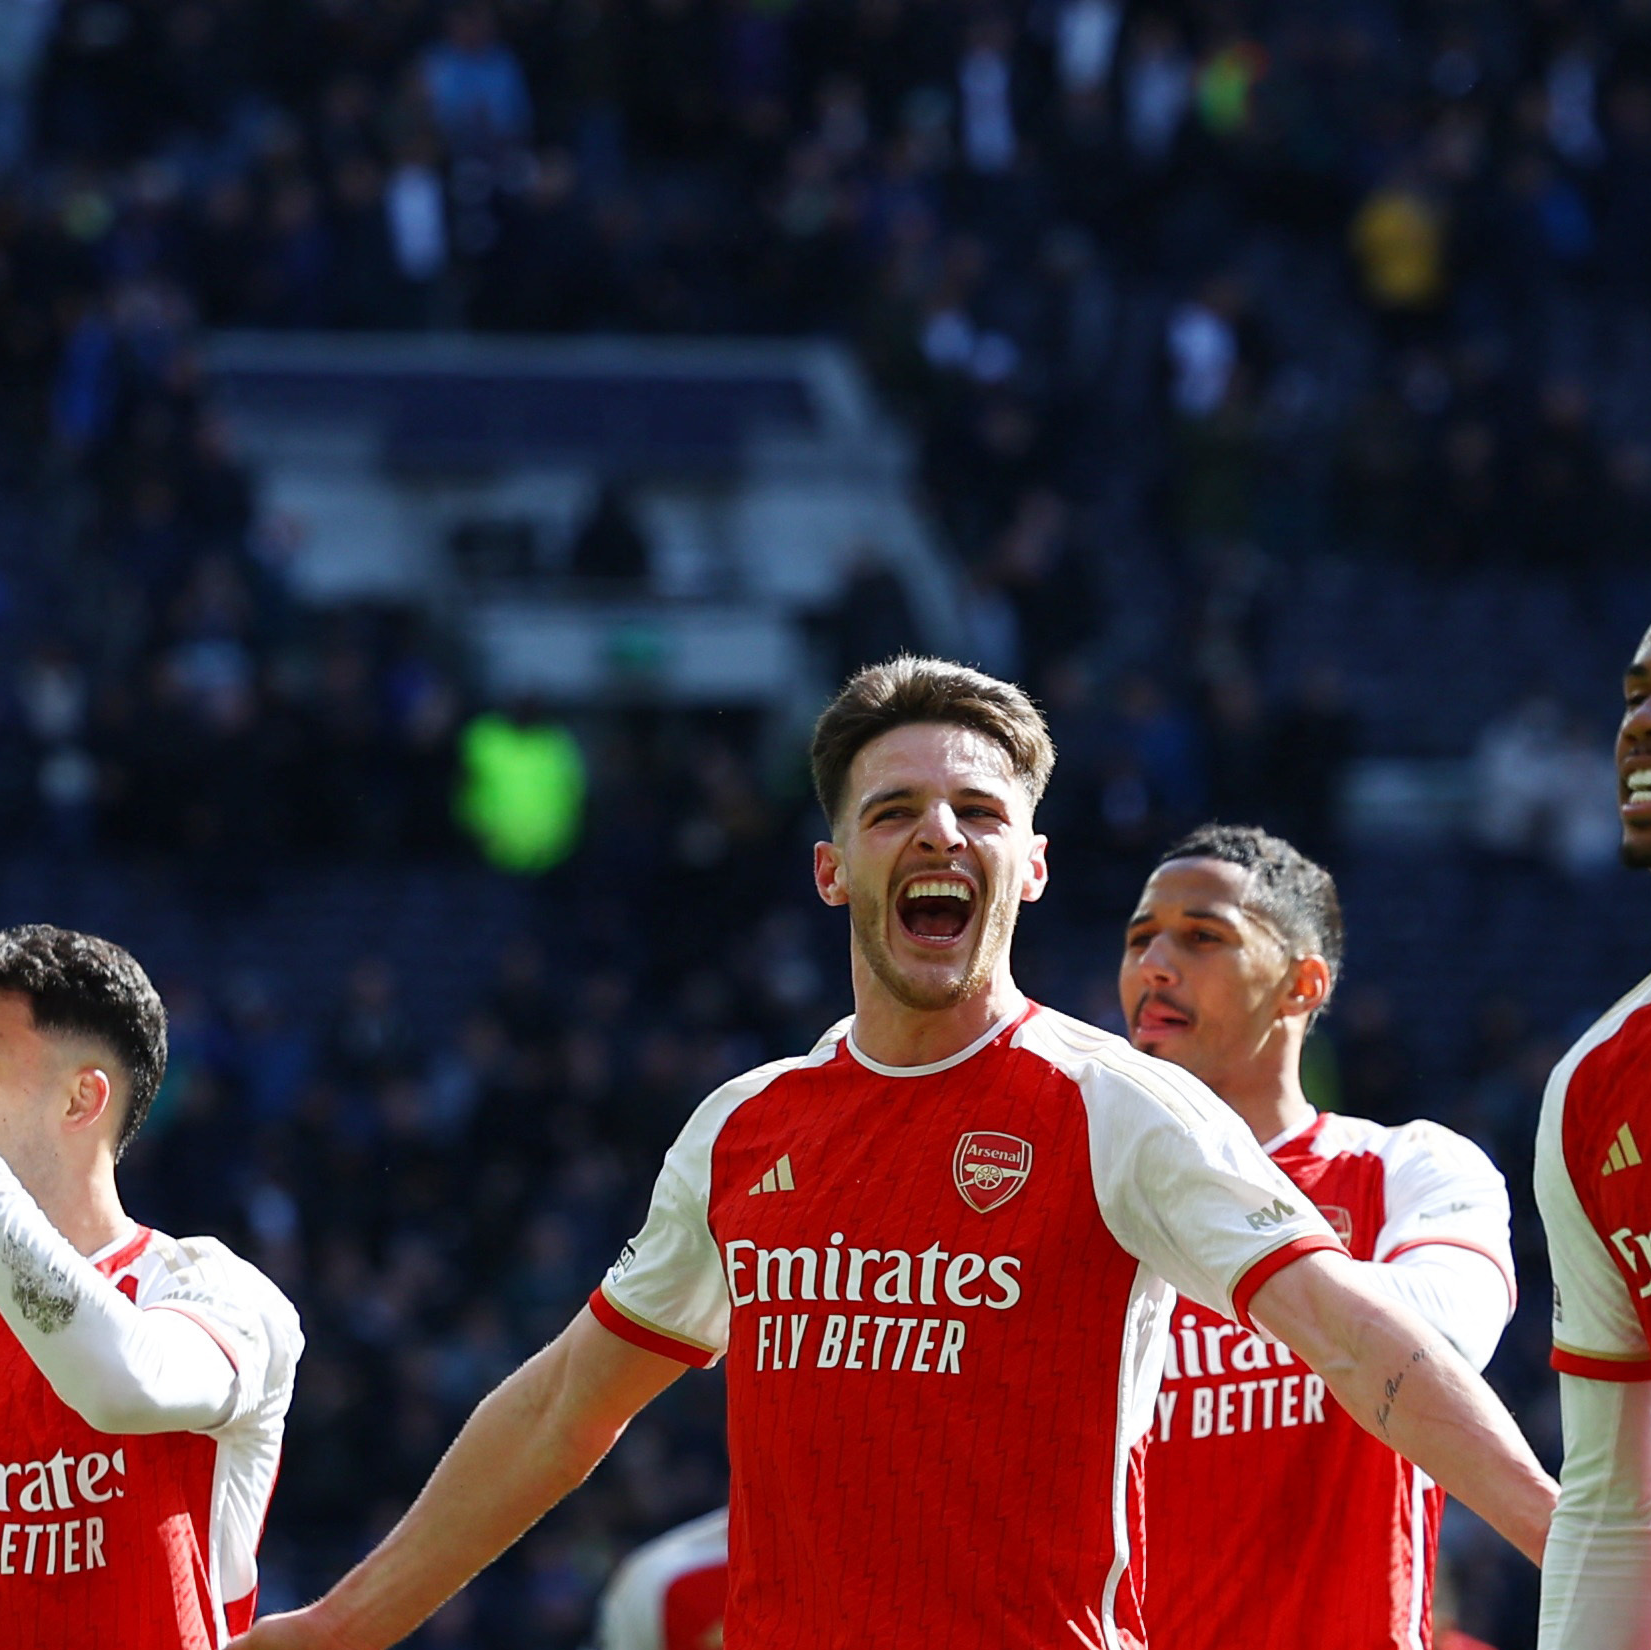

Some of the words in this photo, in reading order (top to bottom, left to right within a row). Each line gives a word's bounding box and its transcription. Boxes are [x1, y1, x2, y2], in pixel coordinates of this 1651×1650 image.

[967, 1144, 1021, 1163] Arsenal
[726, 1232, 1021, 1309] Emirates
[756, 1313, 809, 1373] FLY
[817, 1315, 966, 1375] BETTER
[1191, 1373, 1326, 1439] BETTER
